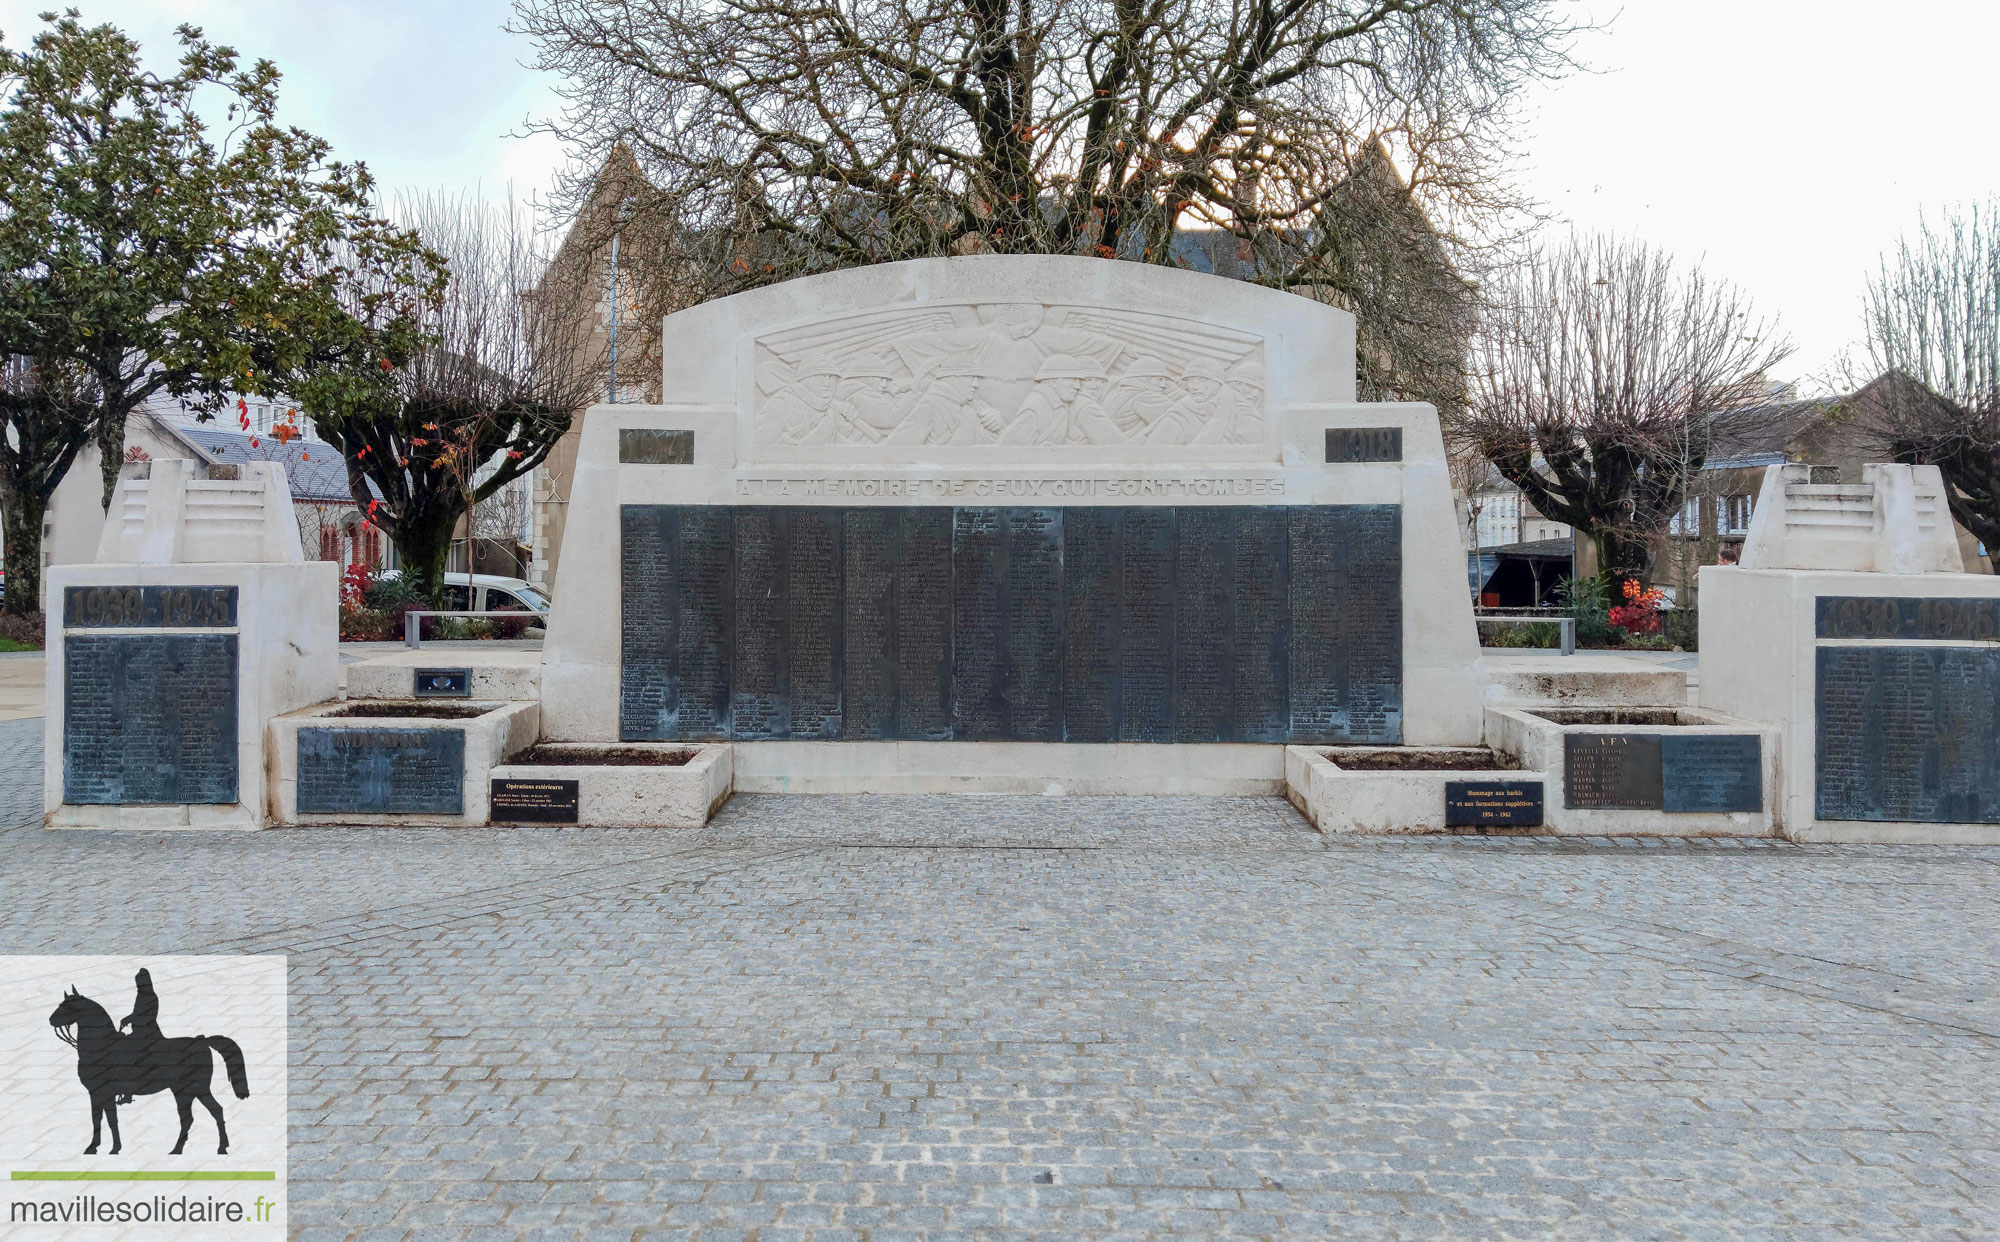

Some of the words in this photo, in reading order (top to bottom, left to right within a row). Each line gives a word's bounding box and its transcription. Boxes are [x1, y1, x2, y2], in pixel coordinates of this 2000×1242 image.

[1334, 430, 1394, 462] 1918
[741, 480, 751, 496] A
[761, 480, 792, 496] LA
[932, 480, 964, 496] DE
[974, 480, 1043, 496] CEUX
[1051, 480, 1096, 496] QUI
[1105, 480, 1172, 496] SONT
[1179, 479, 1285, 496] TOMBES
